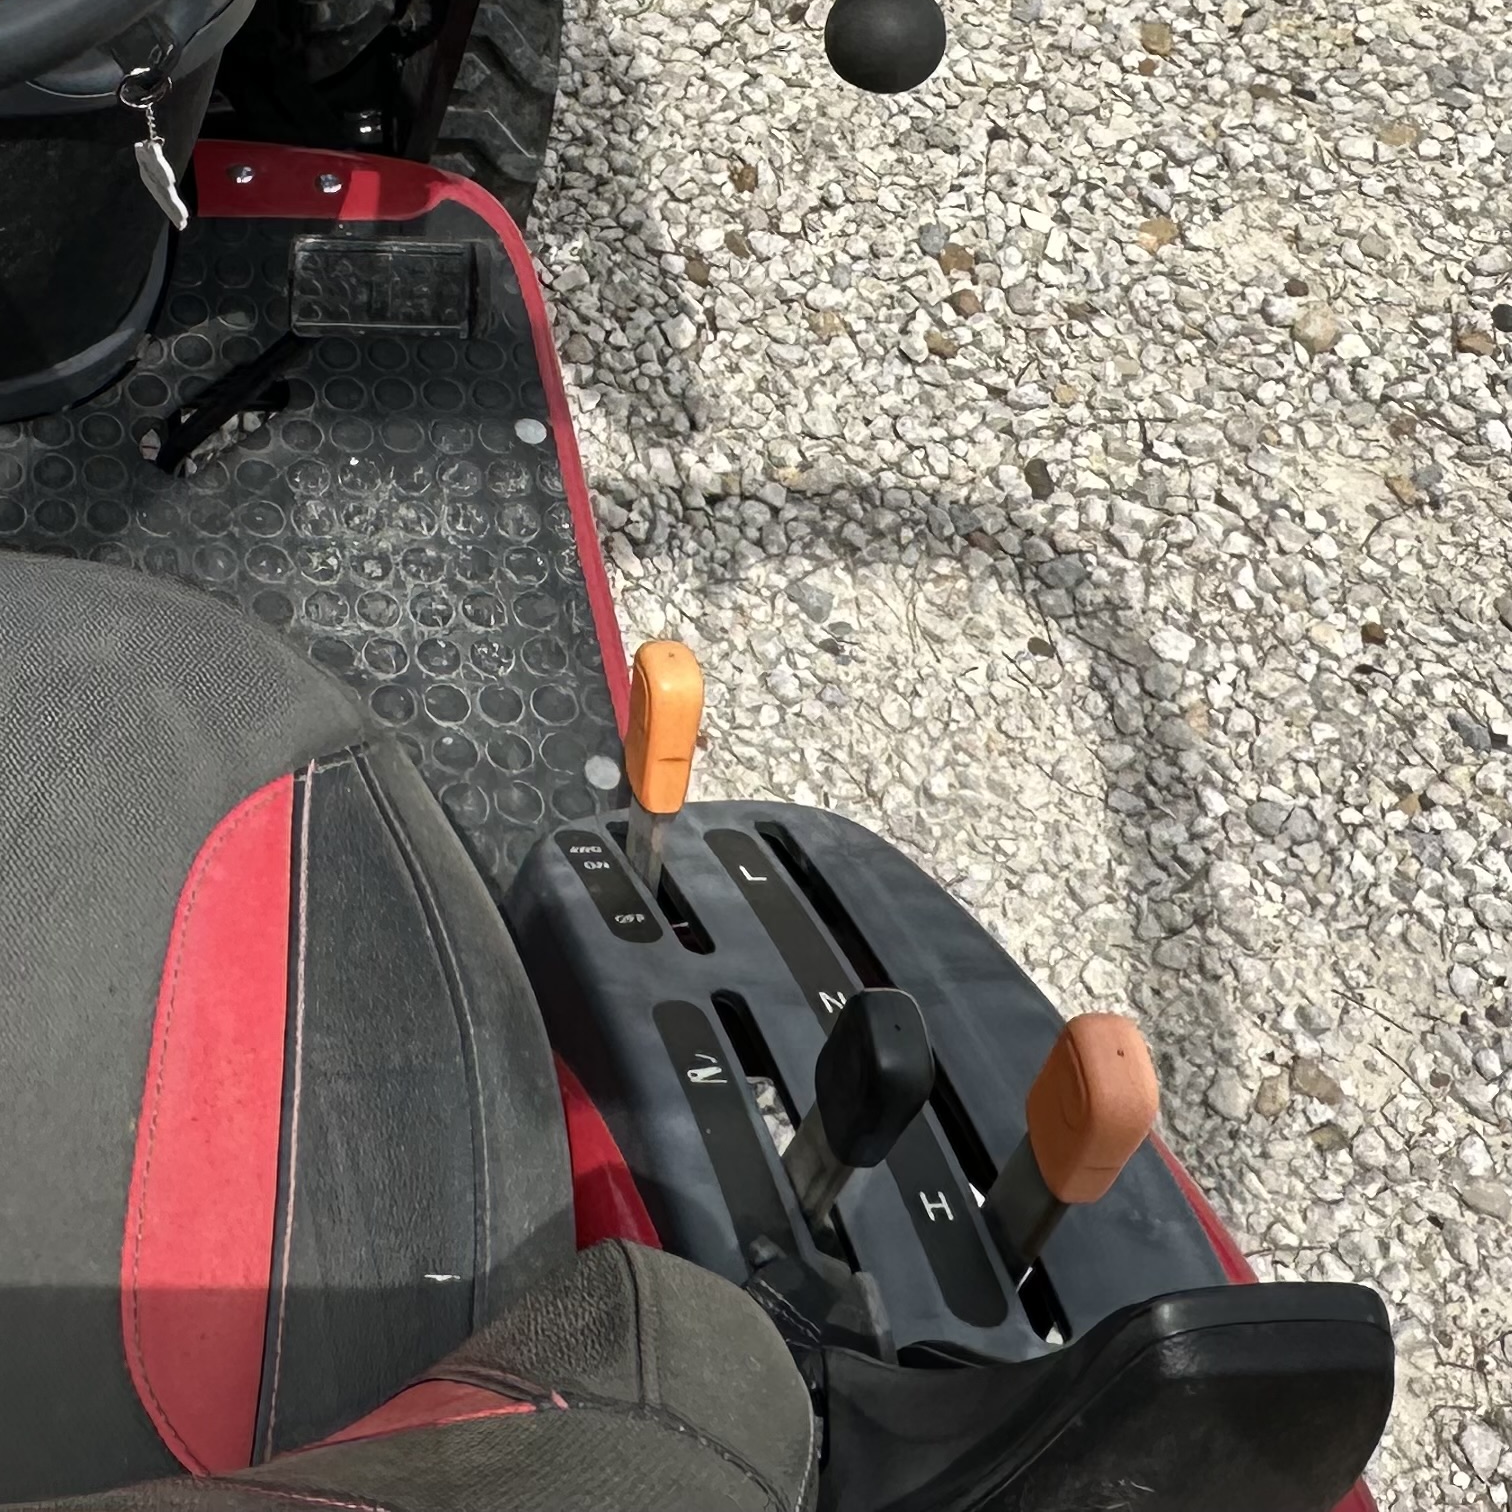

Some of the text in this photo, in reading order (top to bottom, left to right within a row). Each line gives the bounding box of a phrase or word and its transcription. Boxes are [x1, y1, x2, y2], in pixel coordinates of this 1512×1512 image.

[739, 865, 768, 881] L
[818, 991, 847, 1013] N
[919, 1190, 954, 1222] H
